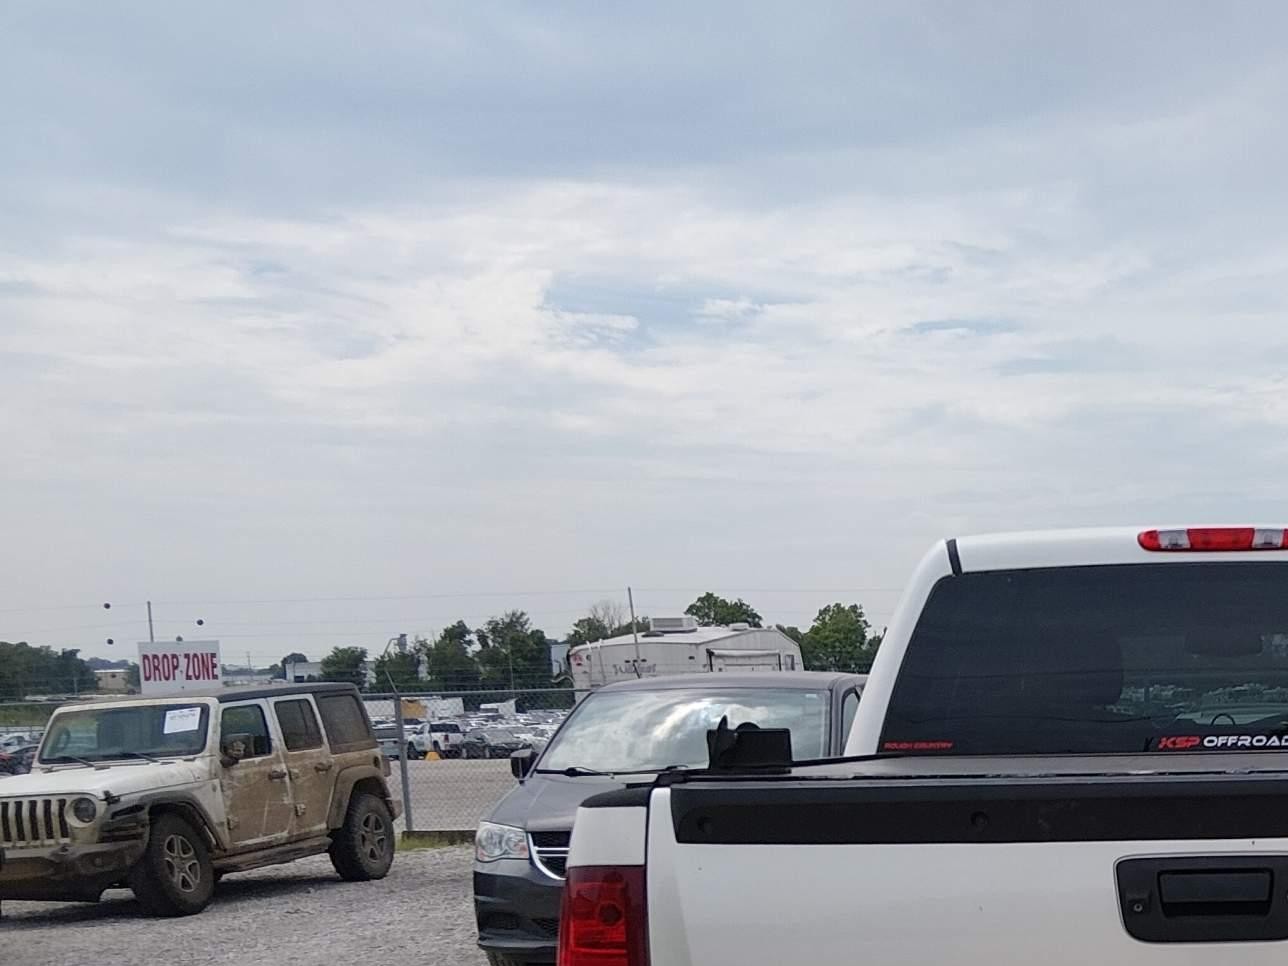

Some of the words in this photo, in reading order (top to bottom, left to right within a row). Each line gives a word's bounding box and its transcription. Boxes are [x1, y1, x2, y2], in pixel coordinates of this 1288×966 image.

[143, 653, 180, 682] DROP
[184, 652, 219, 681] ZONE
[1158, 736, 1201, 749] KSP
